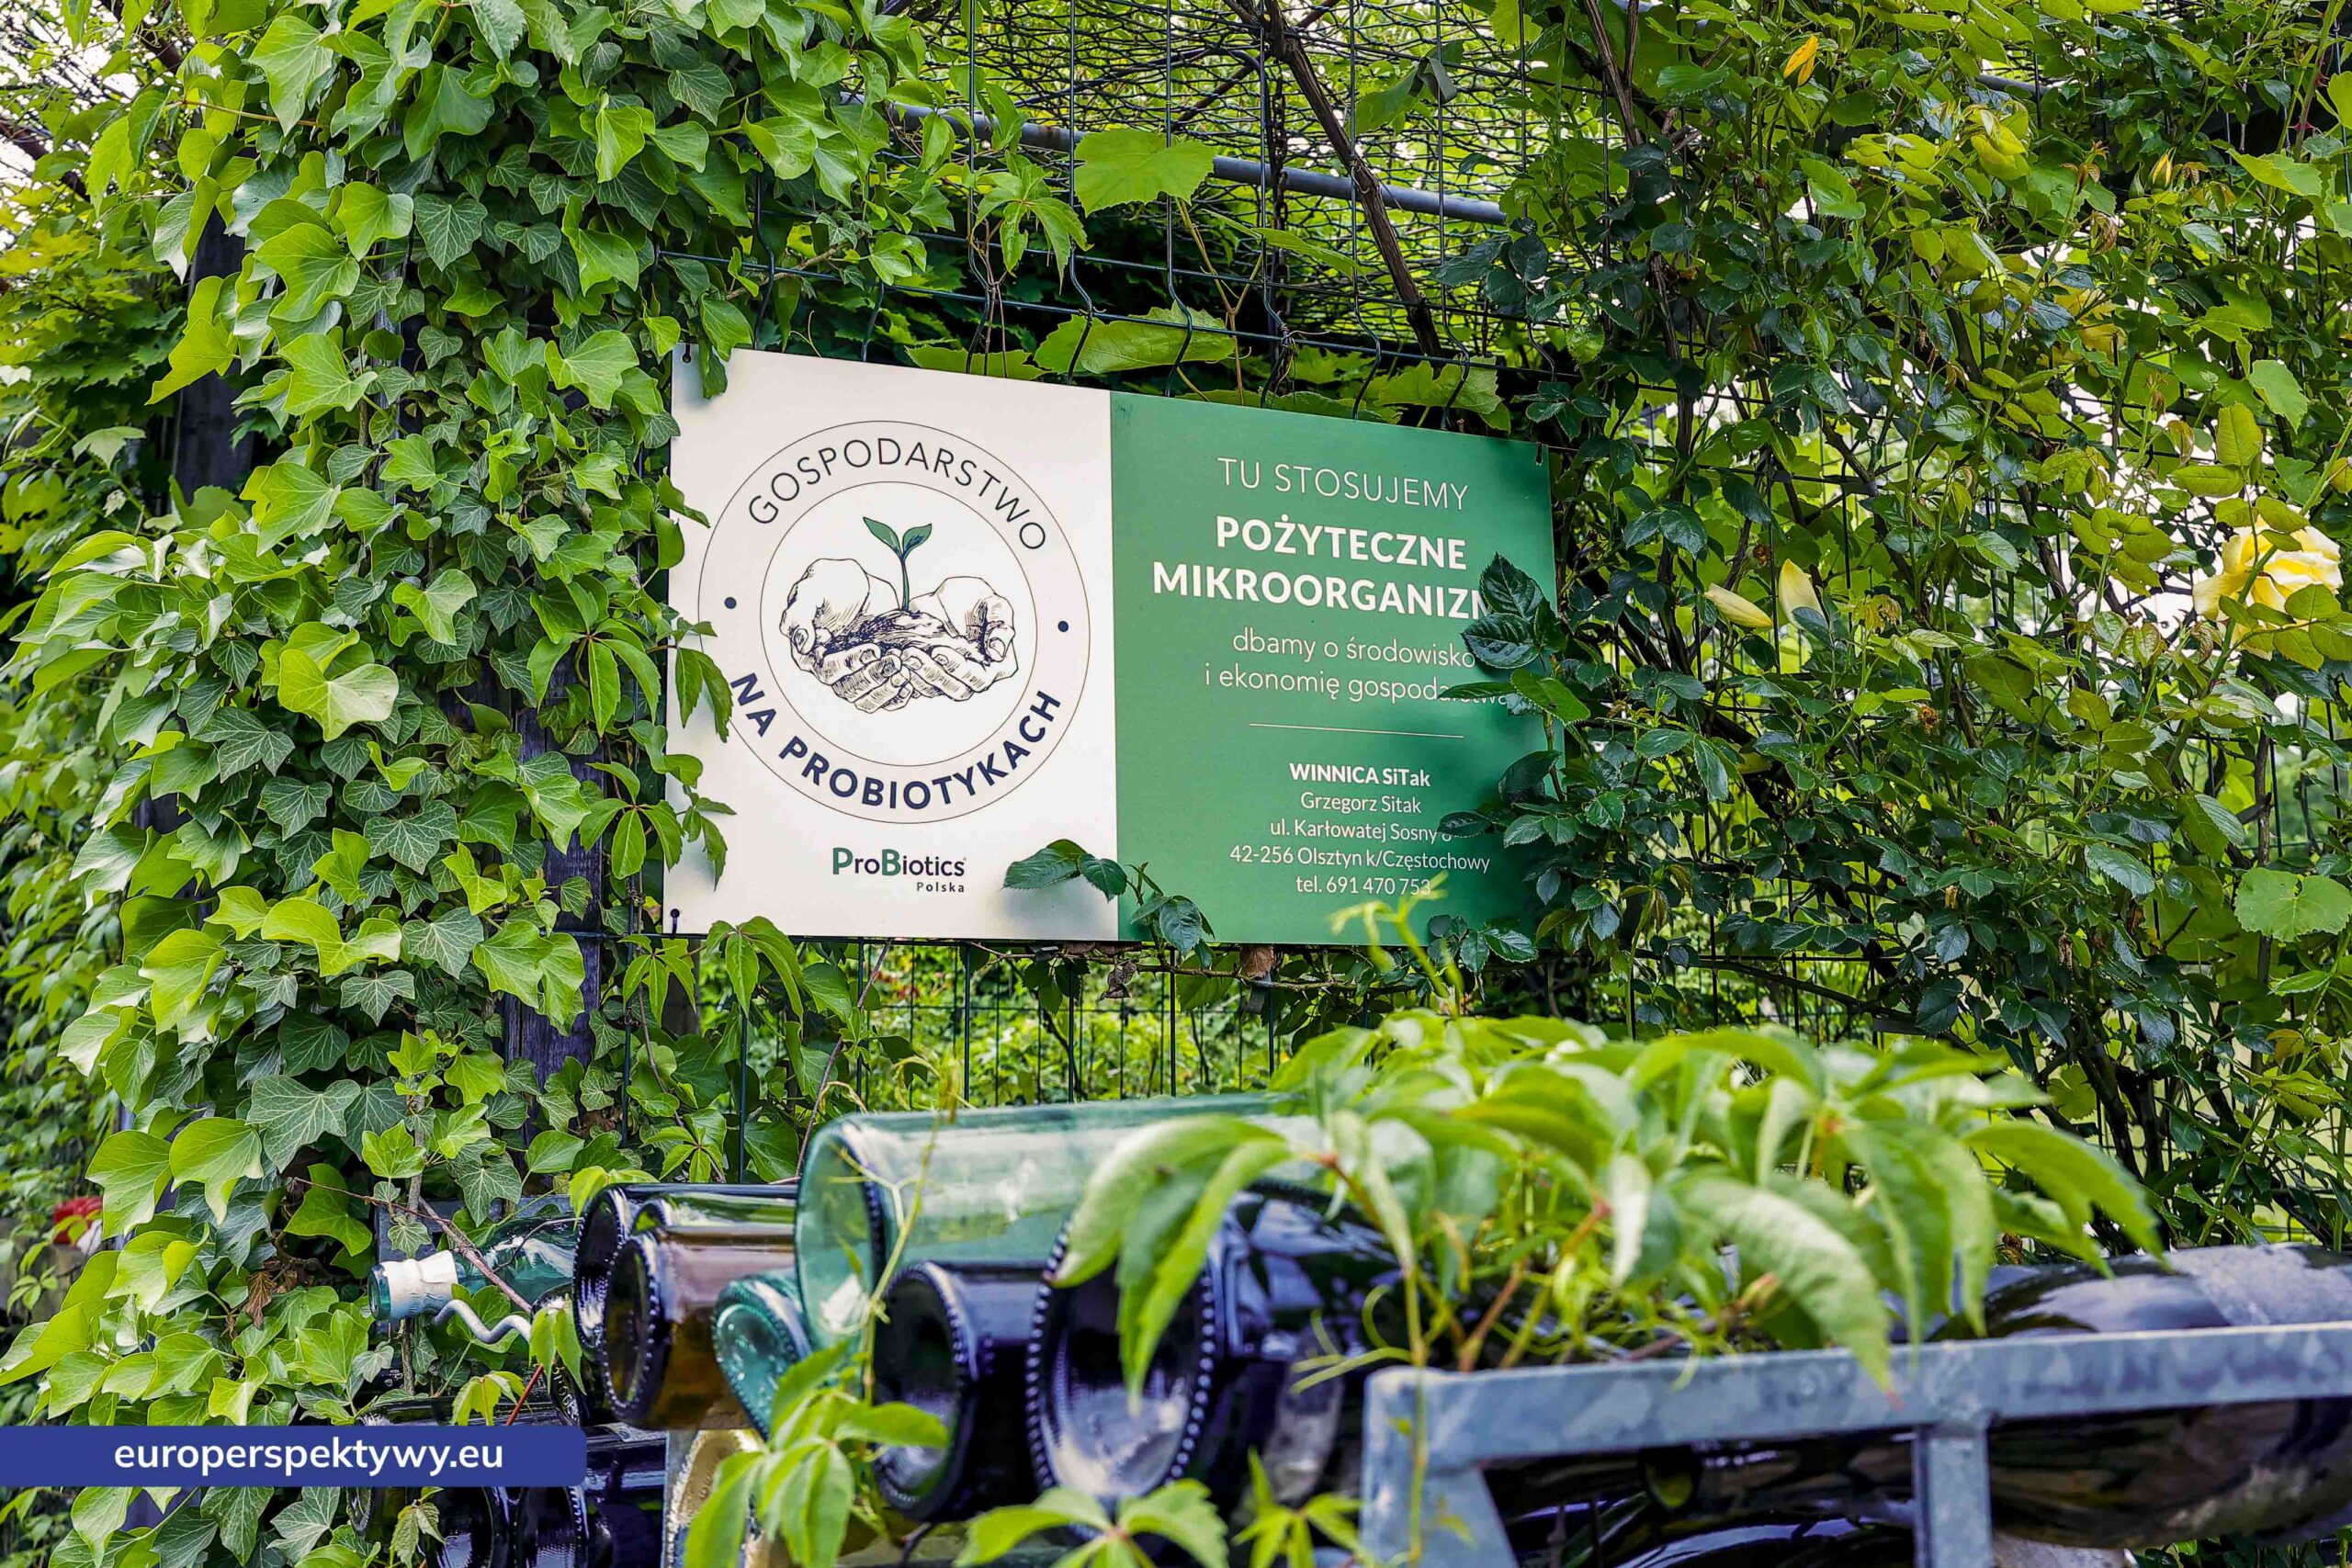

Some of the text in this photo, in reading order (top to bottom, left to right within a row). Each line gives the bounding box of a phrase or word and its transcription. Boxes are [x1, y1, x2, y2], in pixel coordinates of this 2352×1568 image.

[749, 437, 1046, 549] GOSPODARSTWO
[1217, 457, 1468, 511] TU STOSUJEMY
[1216, 513, 1467, 570] POŻYTECZNE
[1152, 561, 1491, 620] MIKROORGANIZ
[1233, 627, 1476, 669] dbamy o środowisko
[1204, 663, 1211, 686] i
[1218, 663, 1340, 700] ekonomię
[730, 672, 1061, 810] NA PROBIOTYKACH
[1289, 762, 1431, 787] WINNICA SiTak
[1300, 792, 1422, 814] Grzegorz Sitak
[1270, 818, 1290, 836] ul.
[1295, 819, 1386, 843] Karłowatej
[1390, 823, 1437, 845] Sosny
[832, 847, 965, 876] ProBiotics
[1229, 844, 1490, 874] 42-256 Olsztyn k/Częstochowy
[917, 882, 965, 893] Polska
[1296, 875, 1323, 893] tel.
[1326, 876, 1360, 894] 691
[1363, 877, 1396, 895] 470
